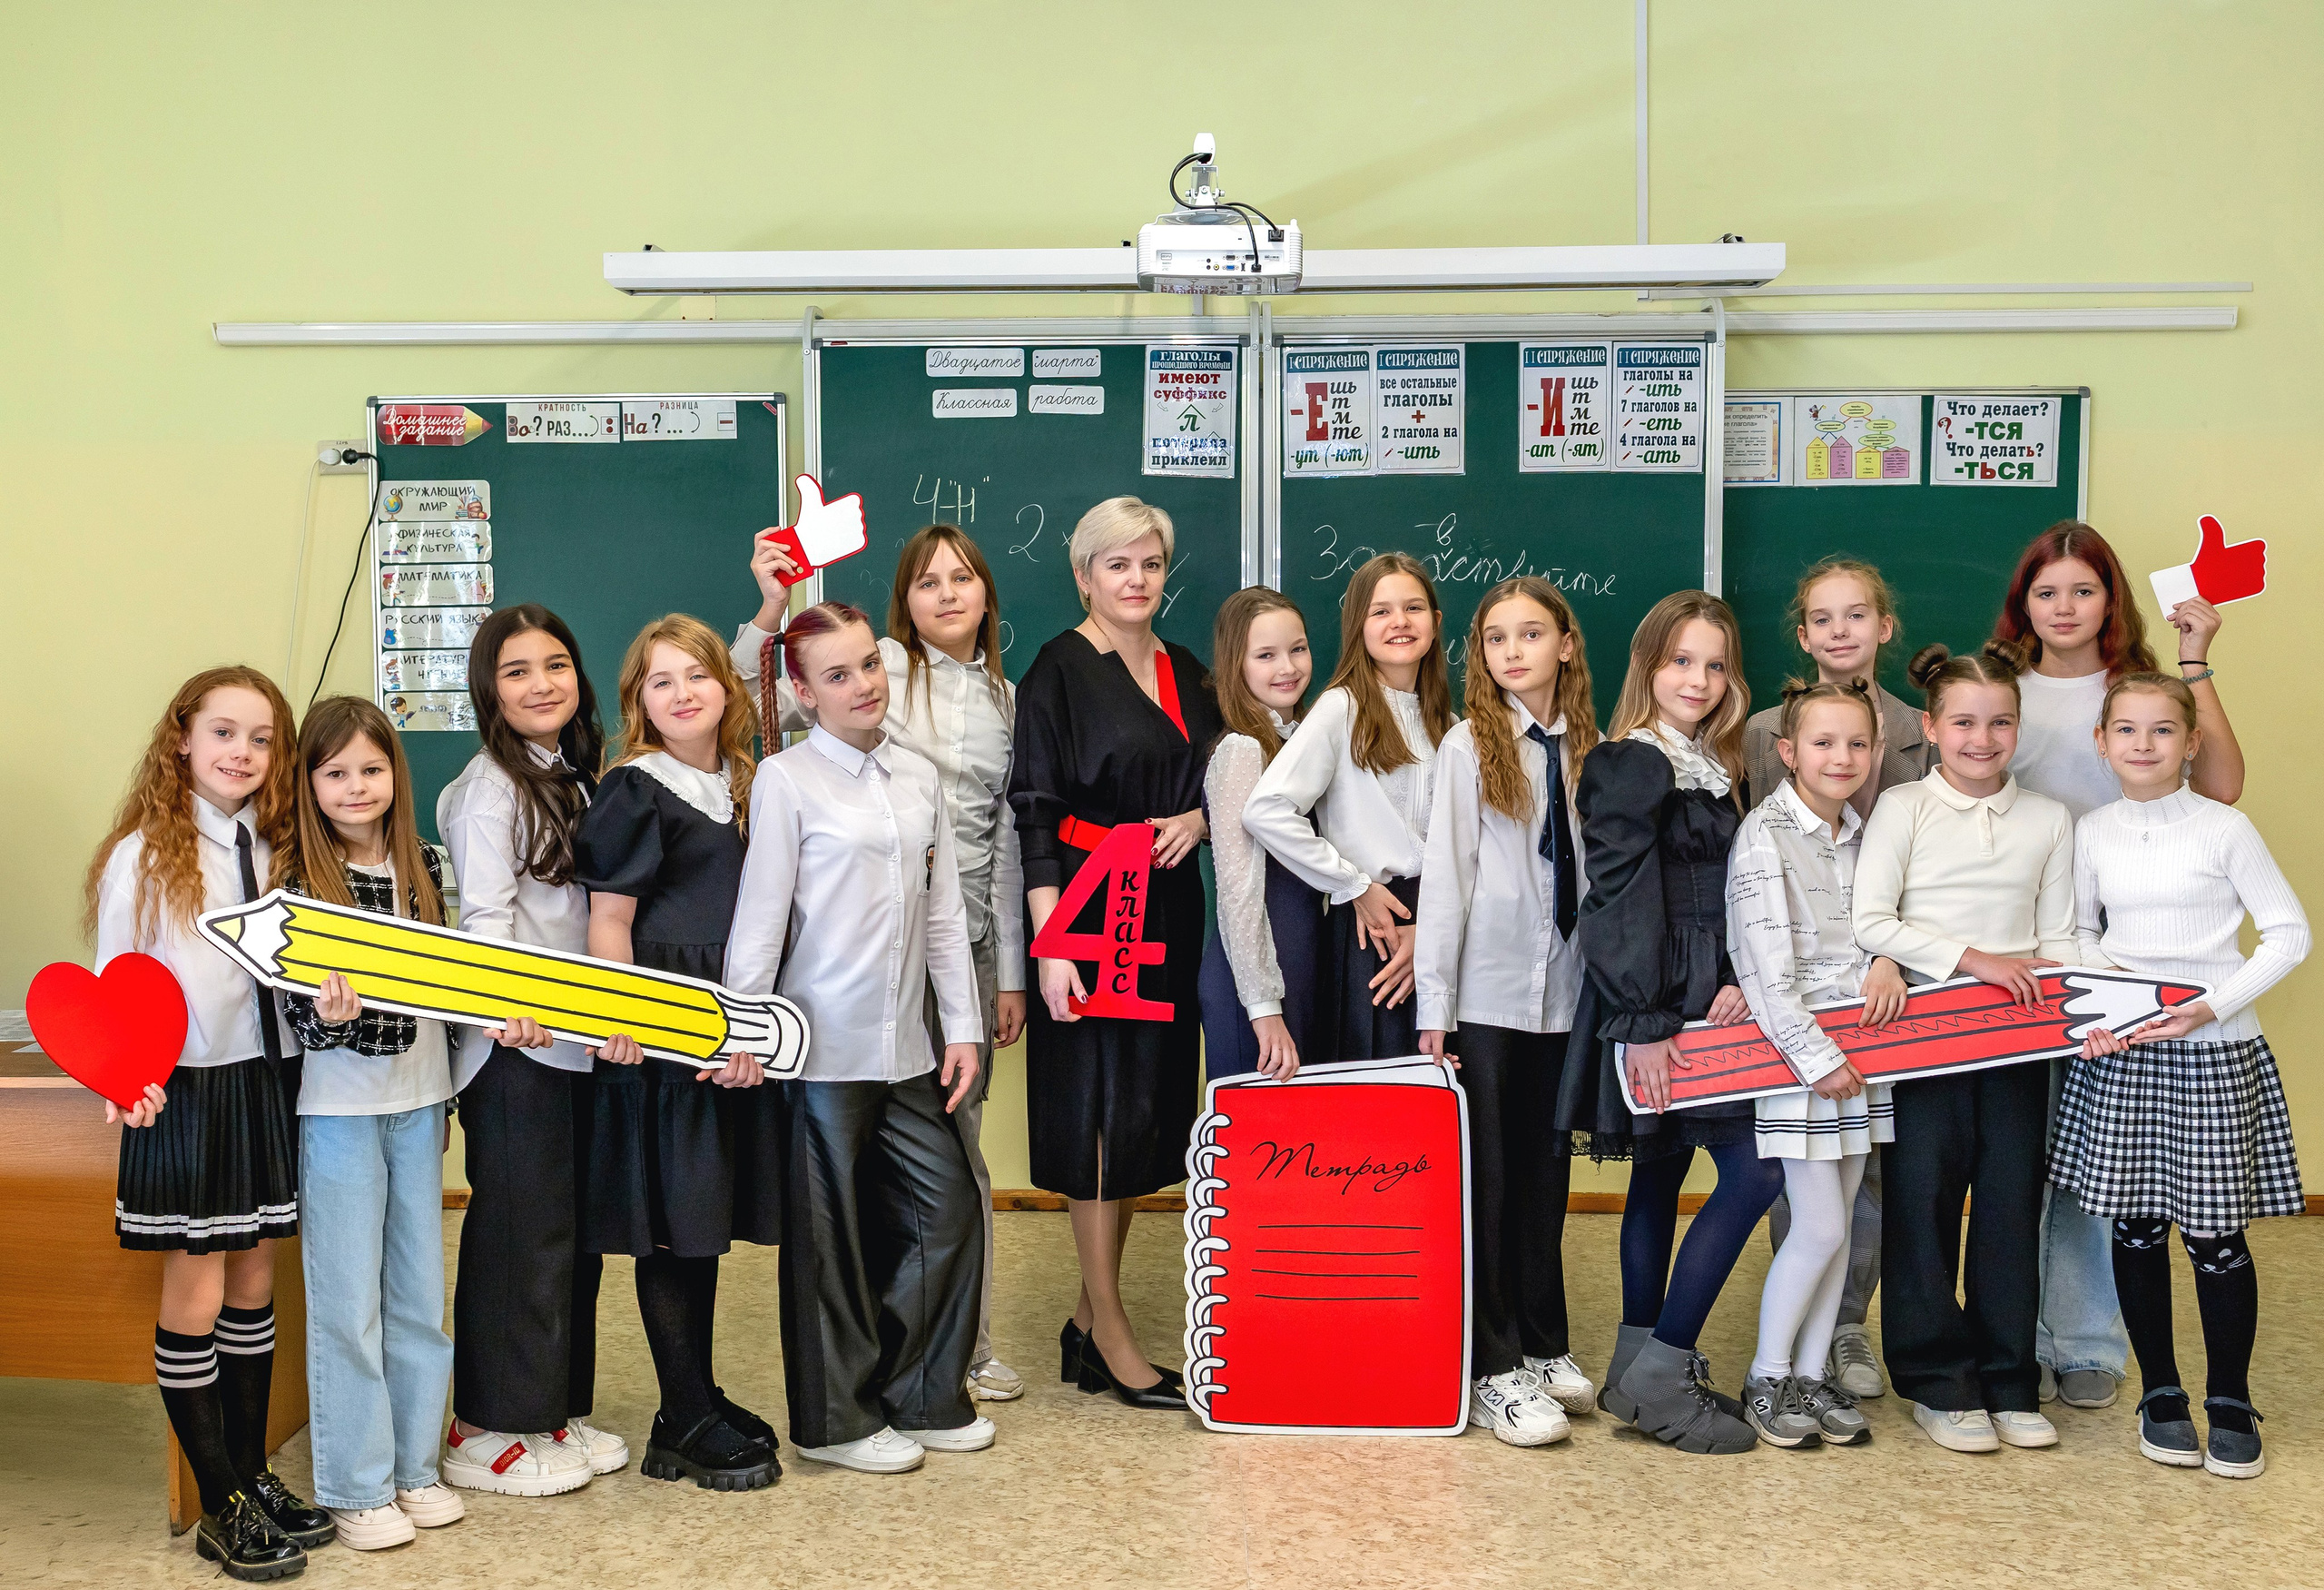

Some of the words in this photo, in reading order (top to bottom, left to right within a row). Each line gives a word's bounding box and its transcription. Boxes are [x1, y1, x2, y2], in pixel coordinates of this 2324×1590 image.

[929, 351, 1021, 374] Двадцатое
[1034, 356, 1098, 374] марта
[1158, 373, 1221, 384] имеют
[1623, 370, 1673, 380] глаголы
[1679, 370, 1693, 380] на
[1380, 378, 1397, 389] все
[1400, 378, 1457, 389] остальные
[936, 392, 1012, 409] Классная
[1031, 388, 1098, 411] работа
[1154, 387, 1227, 402] суффикс
[1384, 394, 1452, 407] глаголы
[538, 403, 586, 412] КРАТНОСТЬ
[660, 402, 699, 410] РАЗНИЦА
[1621, 400, 1627, 412] 7
[1631, 402, 1679, 412] глаголов
[1684, 401, 1697, 412] на
[1947, 401, 1975, 416] Что
[1982, 401, 2049, 418] делает?
[382, 409, 468, 425] Домашнее
[398, 424, 465, 441] задание
[1382, 426, 1389, 439] 2
[1393, 428, 1439, 438] глагола
[1443, 427, 1457, 438] на
[1620, 433, 1627, 446] 4
[1631, 436, 1677, 446] глагола
[1682, 435, 1696, 446] на
[1946, 442, 1974, 457] Что
[1980, 443, 2044, 459] делать?
[1152, 456, 1226, 469] приклеил
[390, 486, 476, 497] ОКРУЖАЮЩИЙ
[419, 501, 448, 511] МИР
[448, 614, 479, 624] ЯЗЫК
[1250, 1141, 1432, 1195] Тетрадь
